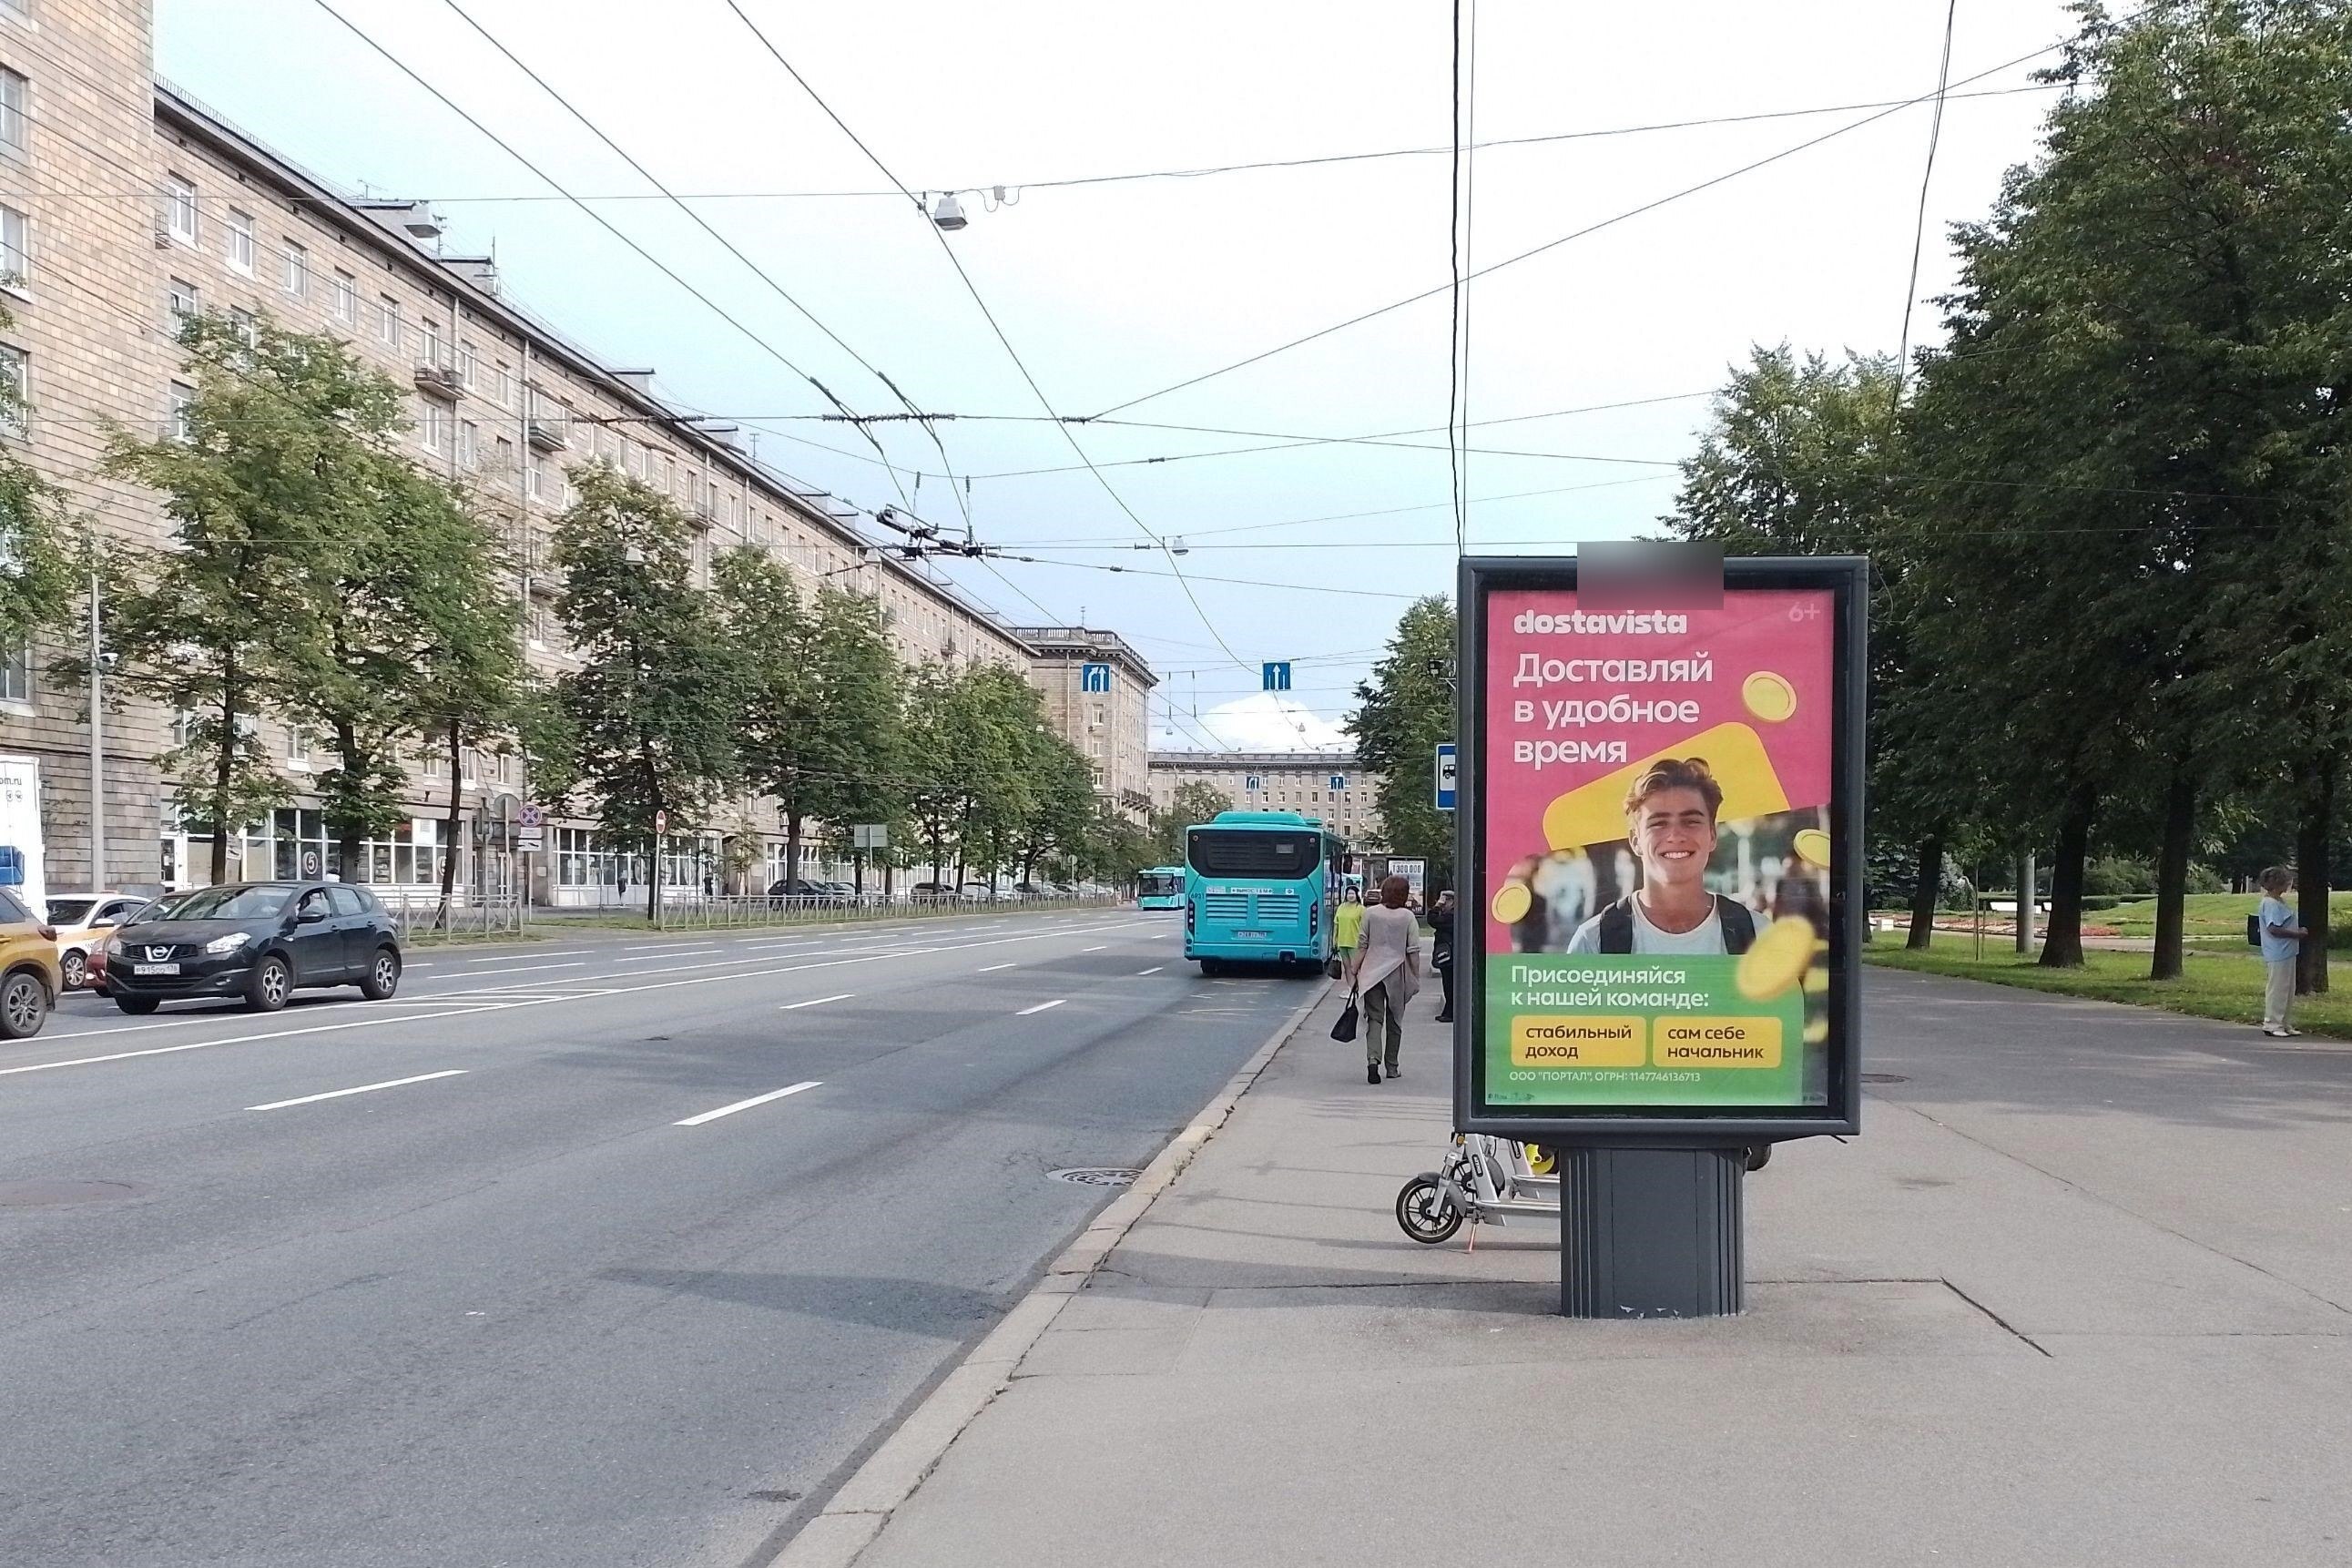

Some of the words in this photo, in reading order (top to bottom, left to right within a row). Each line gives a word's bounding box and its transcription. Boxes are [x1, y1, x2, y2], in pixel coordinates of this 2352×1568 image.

[1513, 609, 1687, 634] dostavista
[1788, 601, 1819, 622] 6+
[1512, 650, 1713, 687] Доставляй
[1514, 700, 1533, 722] в
[1542, 694, 1700, 729] удобное
[1514, 740, 1627, 770] время
[1512, 965, 1685, 986] Присоединяйся
[1512, 992, 1523, 1005] к
[1527, 988, 1602, 1006] нашей
[1606, 993, 1709, 1010] команде:
[1525, 1024, 1632, 1039] стабильный
[1667, 1028, 1701, 1040] сам
[1705, 1025, 1746, 1040] себе
[1525, 1046, 1579, 1060] доход
[1667, 1047, 1764, 1059] начальник
[1510, 1071, 1536, 1081] ООО
[1538, 1071, 1593, 1083] "ПОРТАЛ",
[1594, 1072, 1628, 1082] ОГРН:
[1630, 1072, 1701, 1083] 1147746136713
